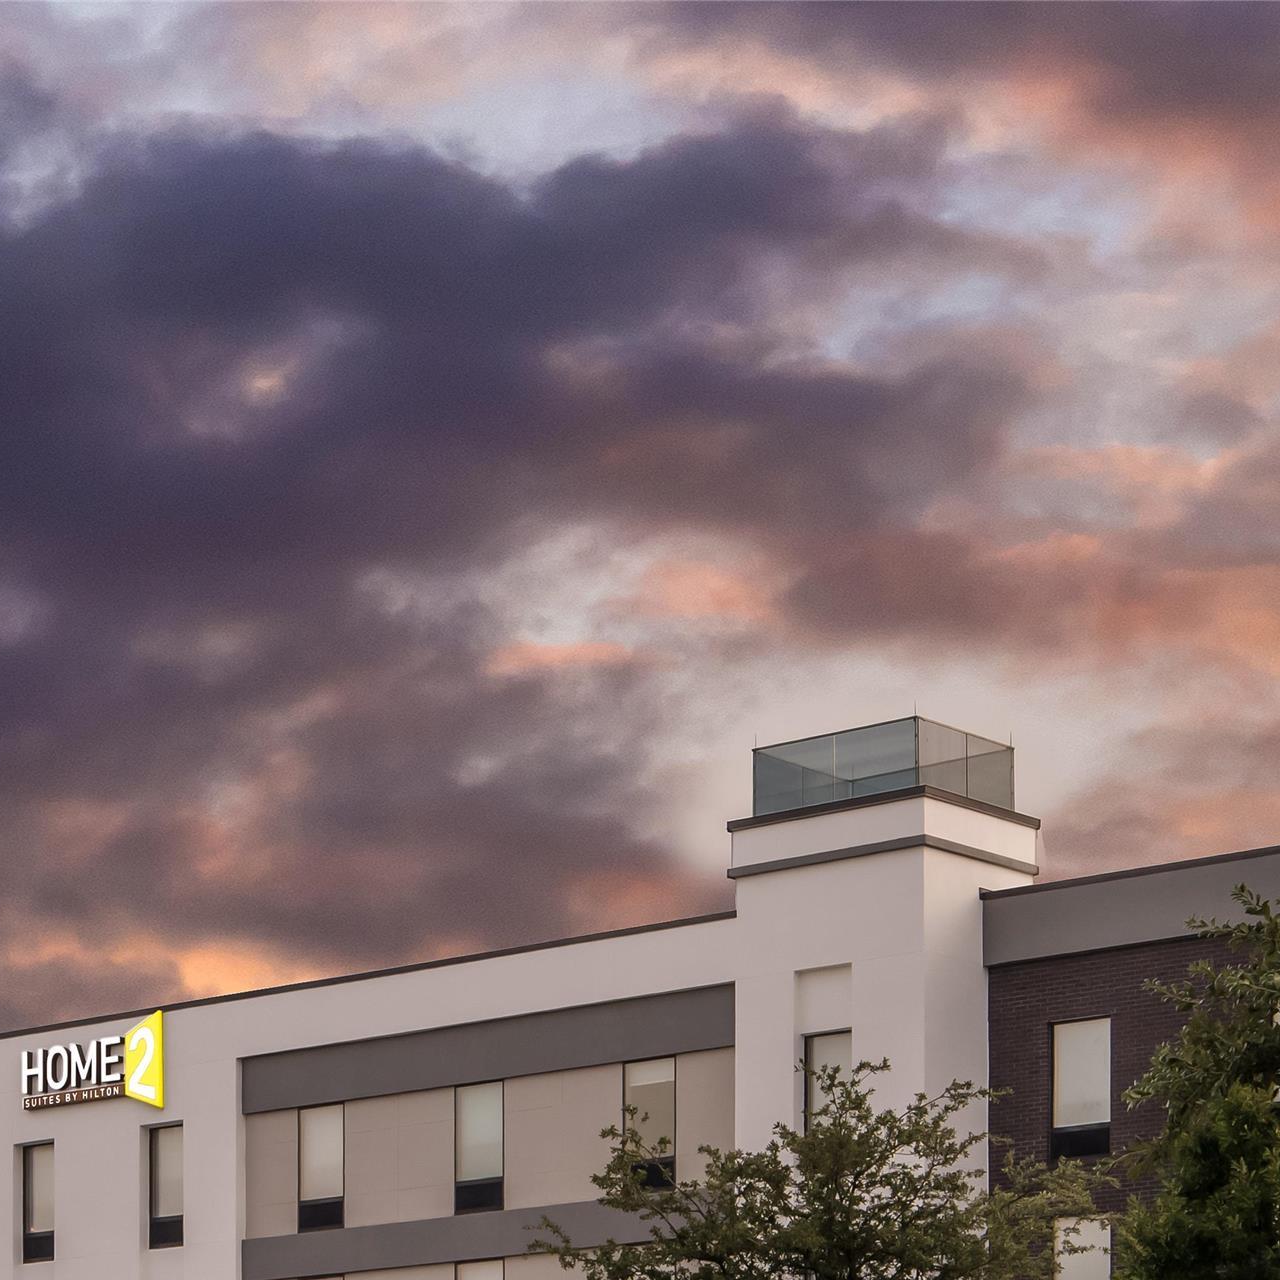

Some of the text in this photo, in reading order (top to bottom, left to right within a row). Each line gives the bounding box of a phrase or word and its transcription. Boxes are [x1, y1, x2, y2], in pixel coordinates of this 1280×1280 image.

[21, 1026, 156, 1100] HOME 2
[25, 1086, 120, 1109] SUITES BY HILTON
